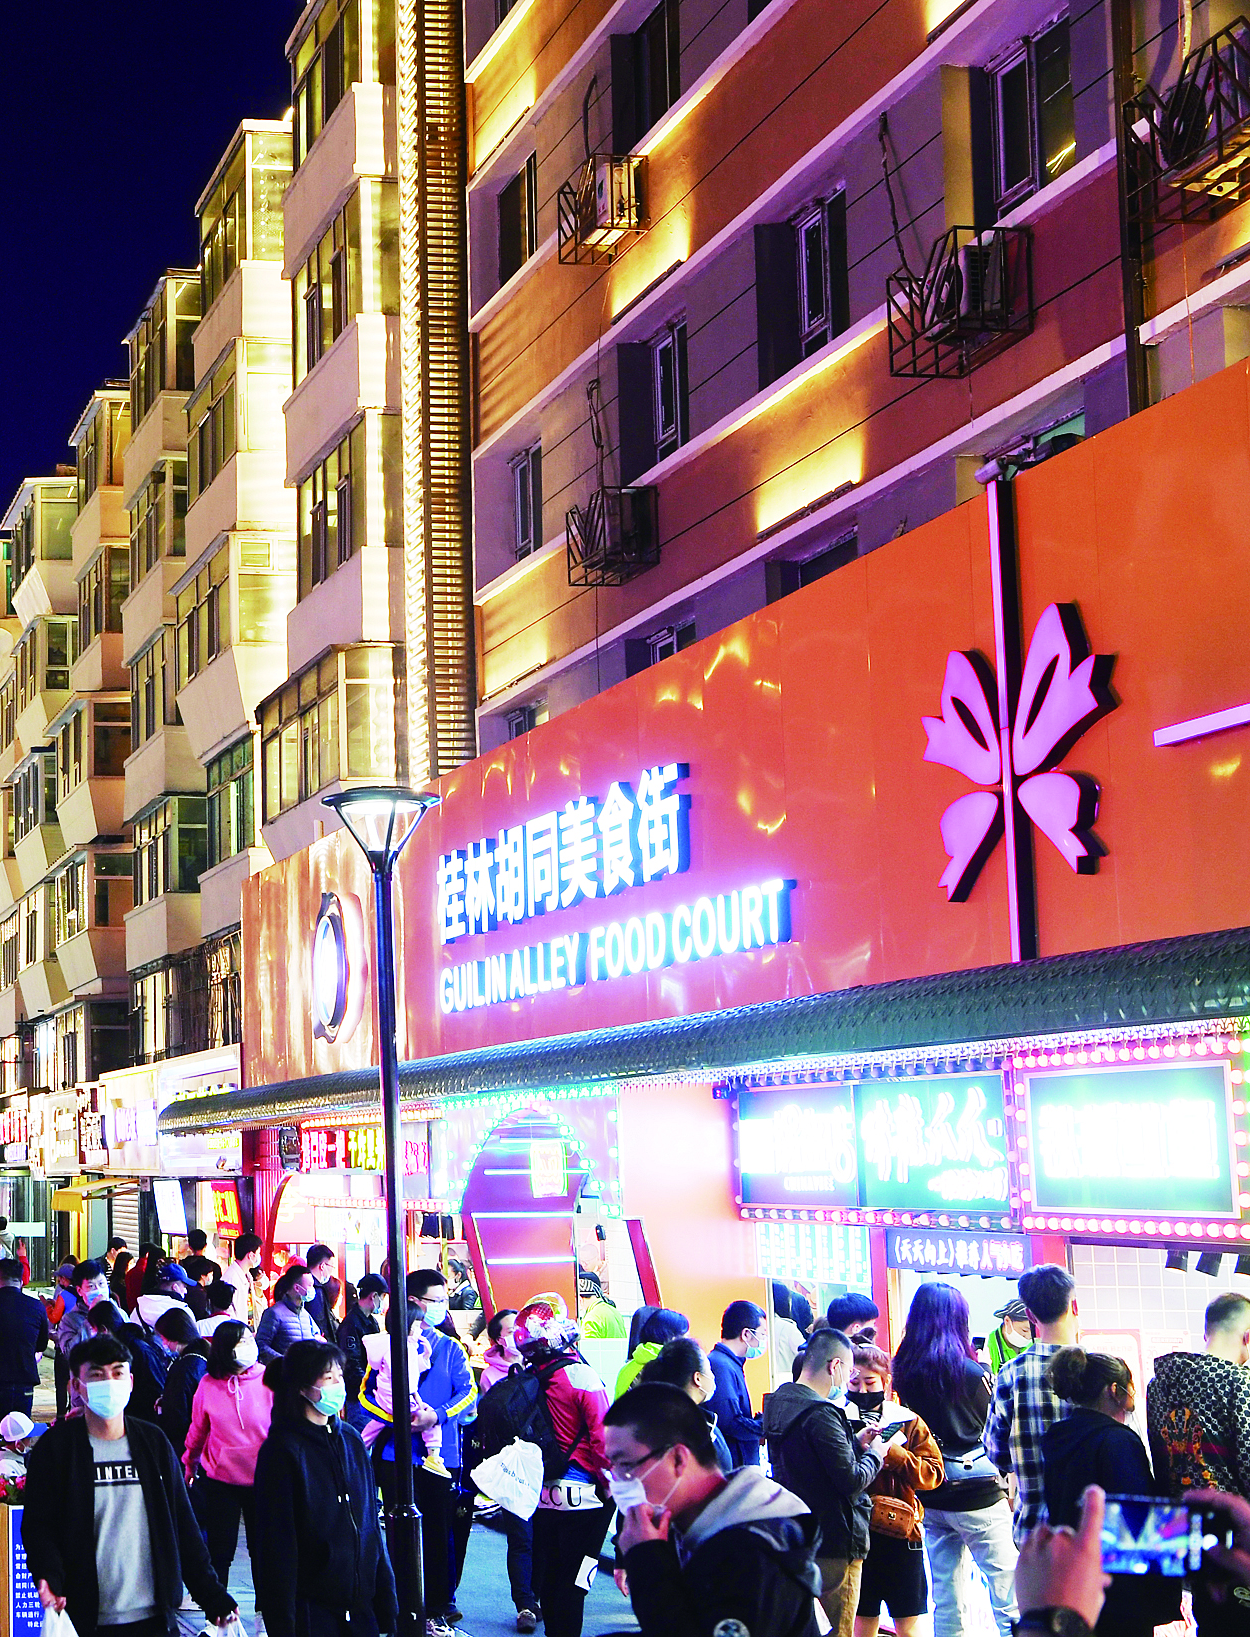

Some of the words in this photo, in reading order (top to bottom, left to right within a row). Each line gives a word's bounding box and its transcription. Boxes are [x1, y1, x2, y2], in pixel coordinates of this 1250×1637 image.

[437, 763, 687, 946] 桂林胡同美食街
[440, 952, 507, 1014] GUILIN
[509, 931, 580, 998] ALLEY
[590, 911, 666, 981] FOOD
[671, 879, 786, 964] COURT
[15, 1601, 43, 1609] 人力三轮
